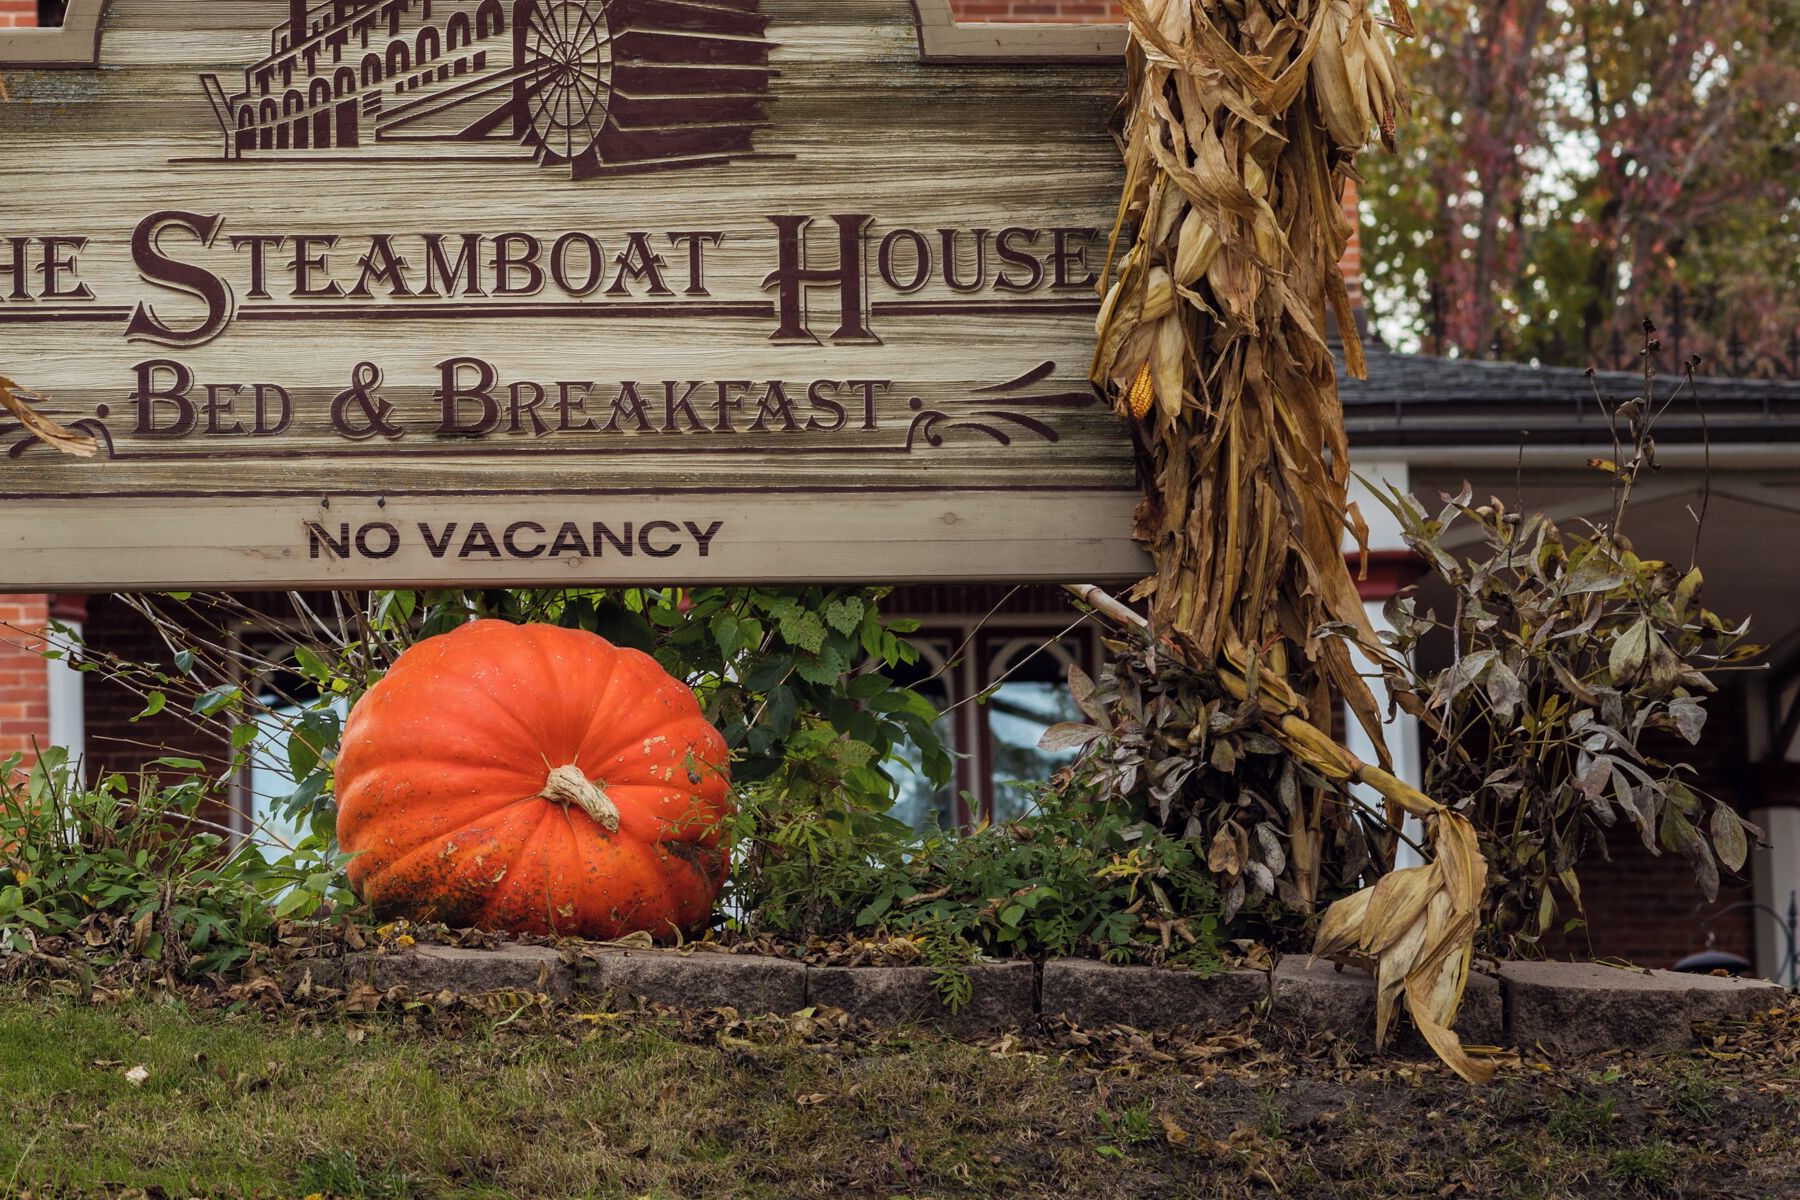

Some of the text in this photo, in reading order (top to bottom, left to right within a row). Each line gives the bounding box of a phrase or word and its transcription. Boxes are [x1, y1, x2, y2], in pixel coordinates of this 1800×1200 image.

[123, 210, 725, 348] STEAMBOAT
[762, 213, 1100, 346] HOUSE
[127, 356, 893, 440] BED & BREAKFAST
[309, 520, 724, 560] NO VACANCY
